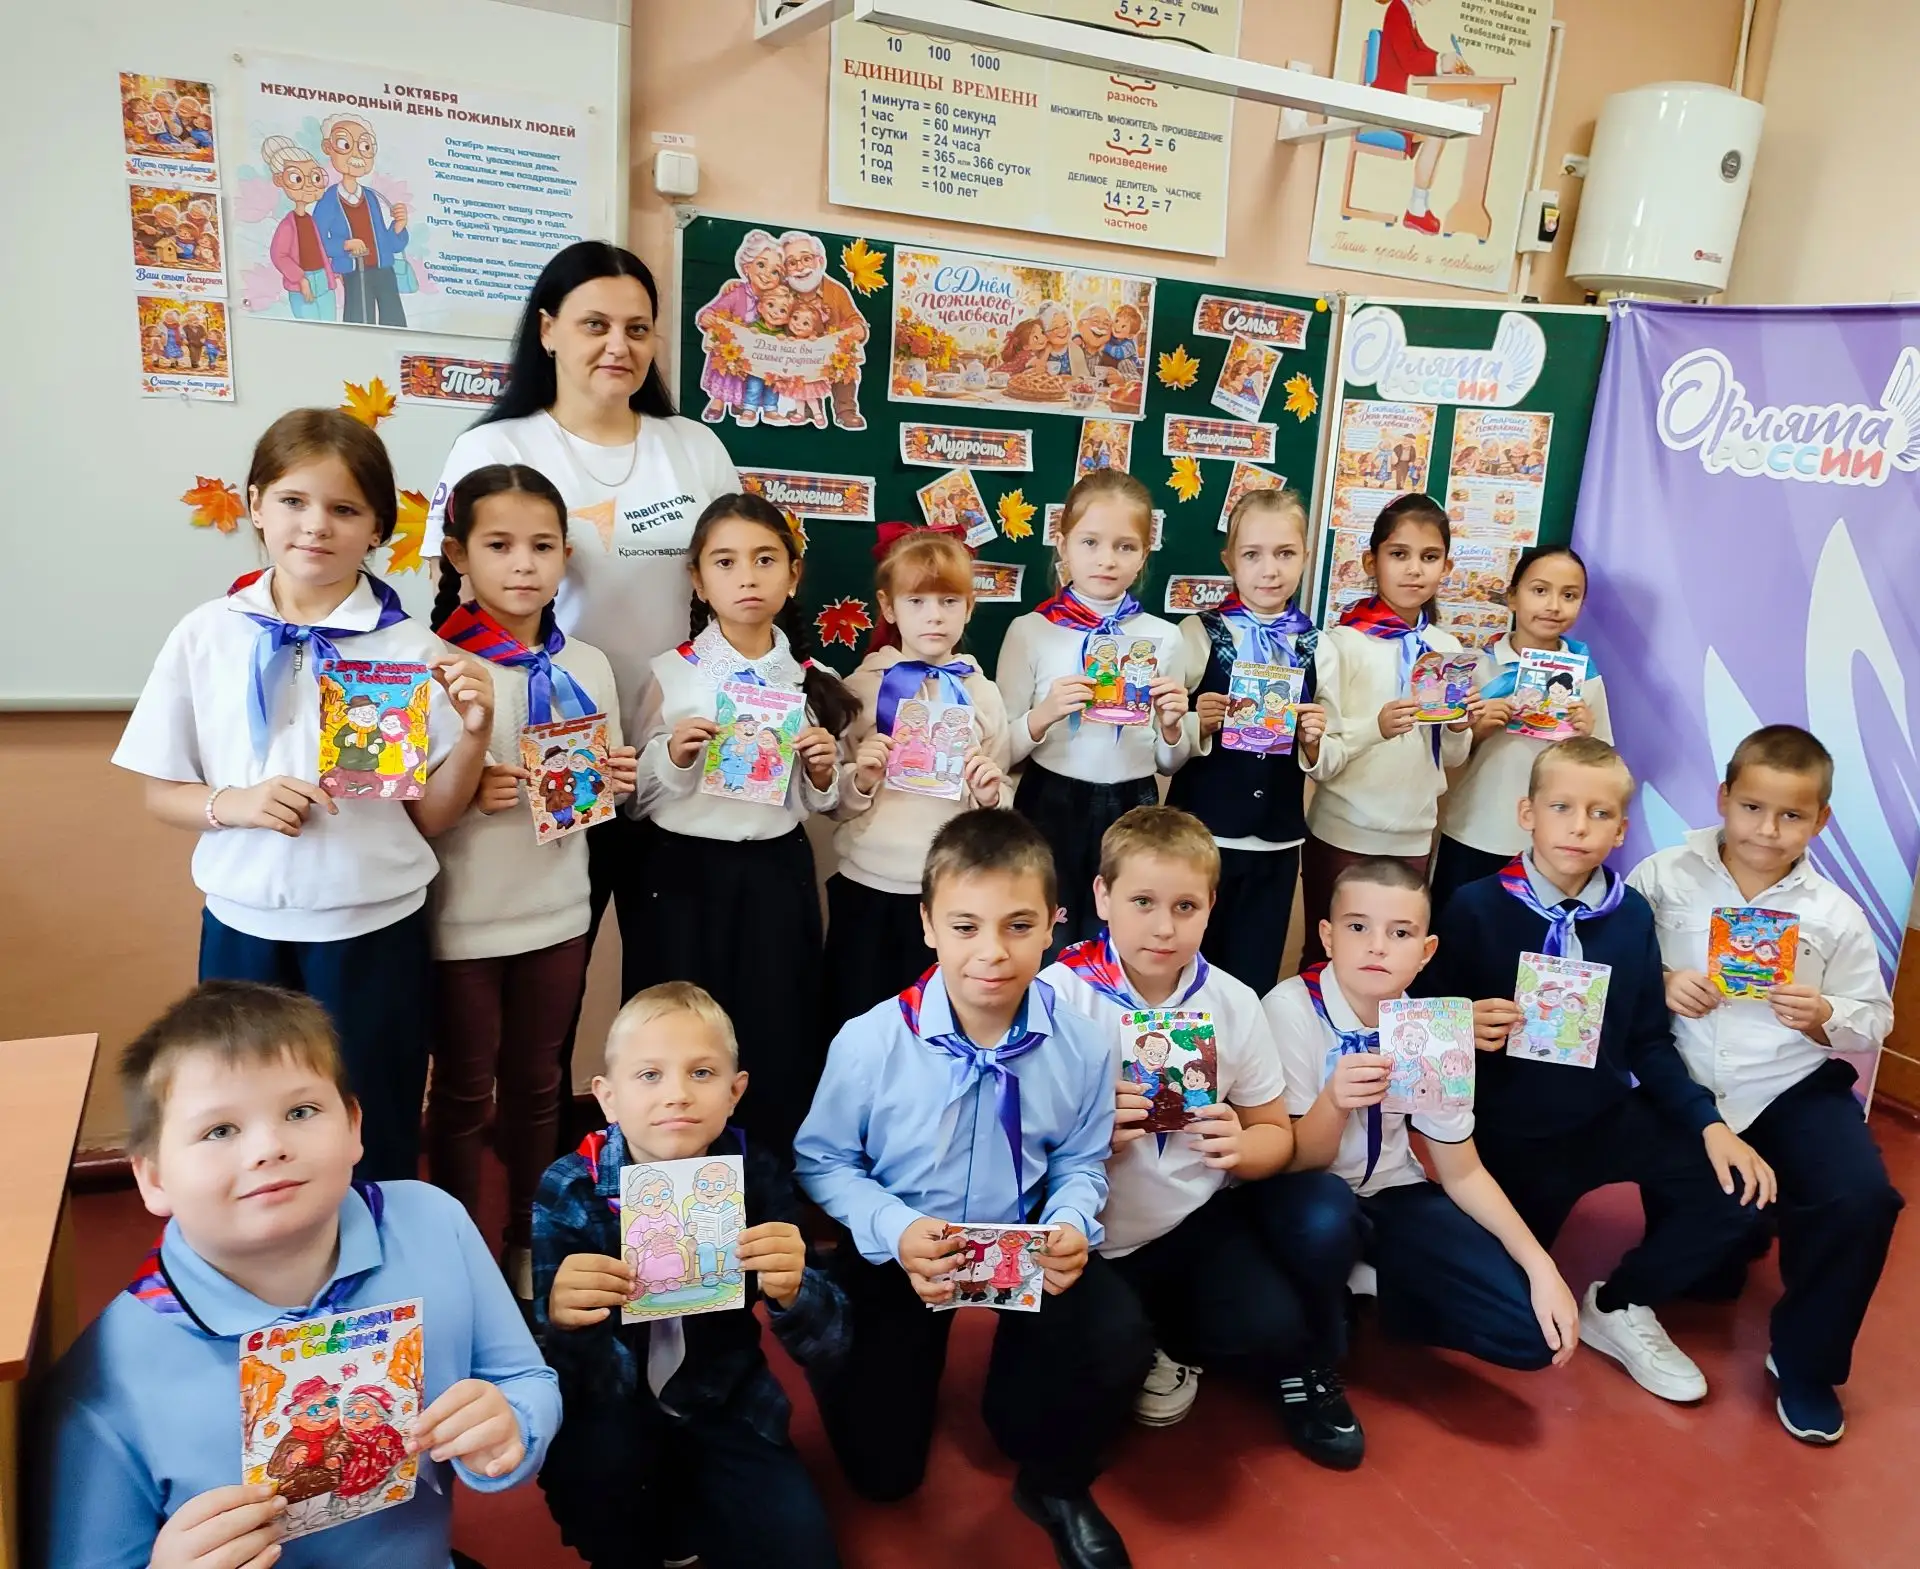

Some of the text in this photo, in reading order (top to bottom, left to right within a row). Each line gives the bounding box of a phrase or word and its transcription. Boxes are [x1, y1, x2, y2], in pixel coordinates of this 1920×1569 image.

[1120, 1, 1186, 26] 5 2 7
[1191, 2, 1218, 15] СУММА
[1489, 9, 1513, 20] чтобы
[887, 37, 1000, 71] 10 100 1000
[383, 83, 458, 104] 1 ОКТЯБРЯ
[844, 58, 1038, 108] ЕДИНИЦЫ ВРЕМЕНИ
[261, 82, 575, 138] МЕЖДУНАРОДНЫЙ ДЕНЬ ПОЖИЛЫХ ЛЮДЕЙ
[861, 89, 996, 125] 1 минута 60 секунд
[1107, 91, 1158, 108] разность
[861, 106, 991, 140] 1 час 60 минут
[1051, 104, 1223, 142] МНОЖИТЕЛЬ МНОЖИТЕЛЬ ПРОИЗВЕДЕНИЕ
[445, 137, 484, 150] Октябрь
[487, 145, 515, 155] месяц
[861, 122, 980, 152] 1 сутки 24 часа
[1113, 129, 1176, 151] 3 2 6
[861, 138, 866, 150] 1
[872, 141, 893, 155] год
[934, 150, 955, 164] 365
[973, 156, 993, 170] 366
[998, 161, 1031, 176] суток
[1089, 153, 1168, 173] произведение
[428, 158, 450, 169] Всех
[453, 164, 497, 174] пожилых
[517, 173, 577, 186] поздравляем
[861, 154, 1003, 187] 1 год 12 месяцев
[435, 171, 571, 197] Желаем много светлых дней!
[861, 170, 977, 198] 1 век 100 лет
[1068, 172, 1201, 200] ДЕЛИМОЕ ДЕЛИТЕЛЬ ЧАСТНОЕ
[433, 193, 573, 219] Пусть уважают вашу старость
[1106, 191, 1172, 212] 14 2 7
[427, 215, 582, 242] Пусть будней трудовых усталость
[452, 230, 464, 238] Не
[1104, 218, 1148, 231] частное
[439, 251, 483, 264] Здоровья
[509, 259, 544, 271] благопо
[136, 267, 159, 281] Ваш
[428, 273, 463, 284] Родных
[934, 266, 1015, 298] С Днём
[446, 287, 484, 298] Соседей
[487, 292, 522, 302] добрых
[938, 307, 1015, 326] человека!
[1222, 307, 1278, 336] Семья
[752, 352, 783, 362] самые
[753, 339, 777, 351] Для
[1350, 316, 1504, 392] Орлята
[441, 365, 501, 396] Теп
[1664, 355, 1894, 456] Орлята
[927, 434, 1006, 460] Мудрость
[763, 480, 844, 507] Уважение
[631, 510, 683, 534] ДЕТСТВА
[618, 547, 688, 558] Красногварде
[973, 576, 995, 590] та
[248, 1331, 263, 1351] С
